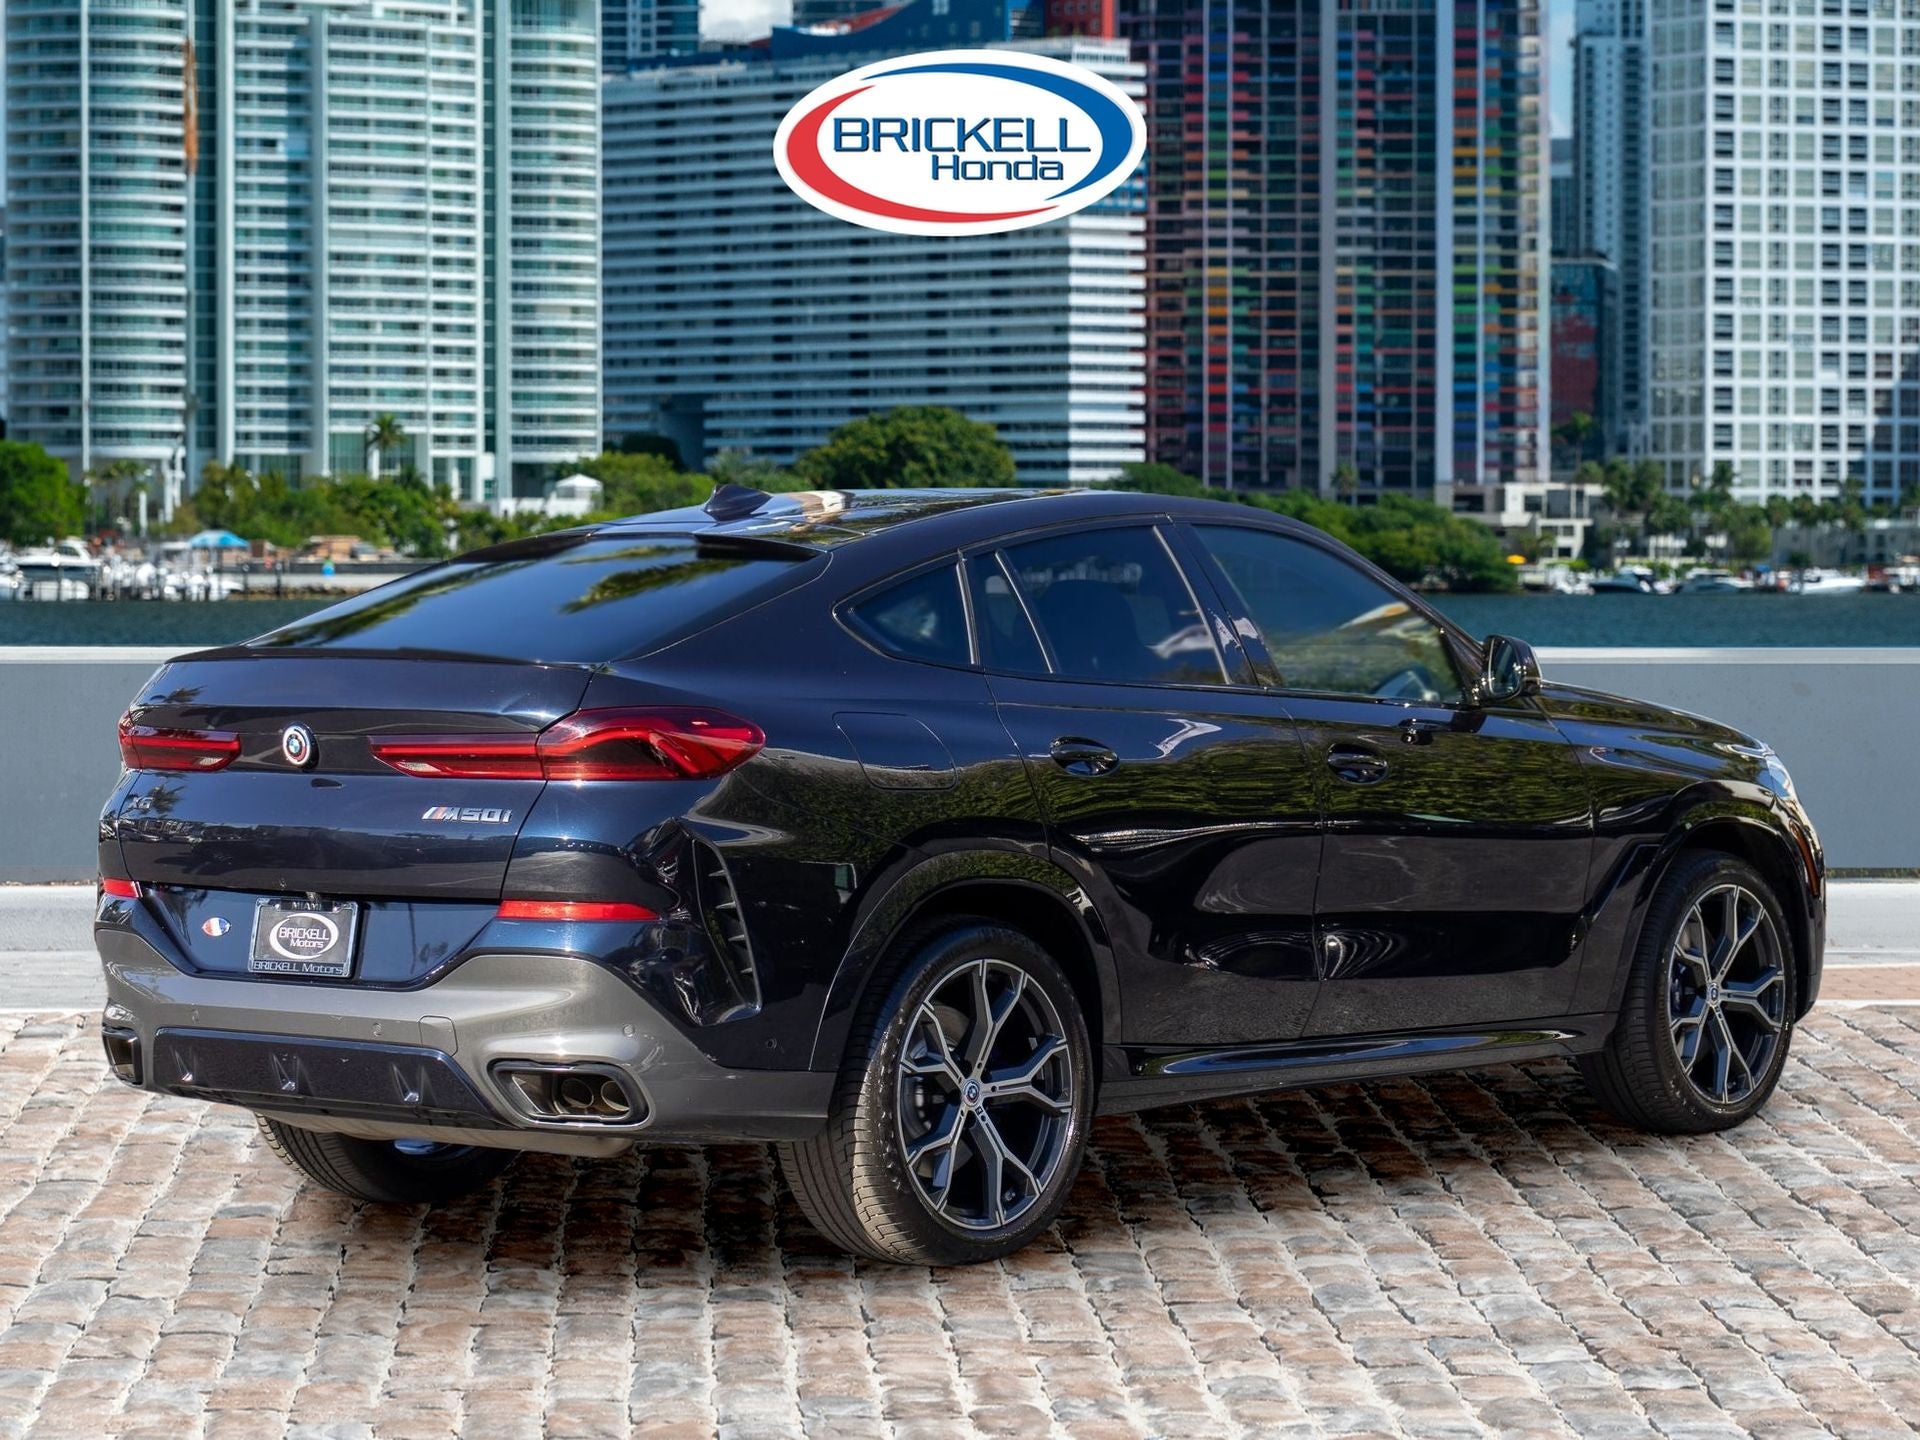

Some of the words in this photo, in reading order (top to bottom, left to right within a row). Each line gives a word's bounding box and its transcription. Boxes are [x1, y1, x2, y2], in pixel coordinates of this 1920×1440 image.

[291, 902, 322, 911] MIAMI
[279, 927, 330, 941] BRICKELL
[290, 939, 324, 949] Motors
[254, 960, 300, 972] BRICKELL
[301, 962, 343, 975] Motors
